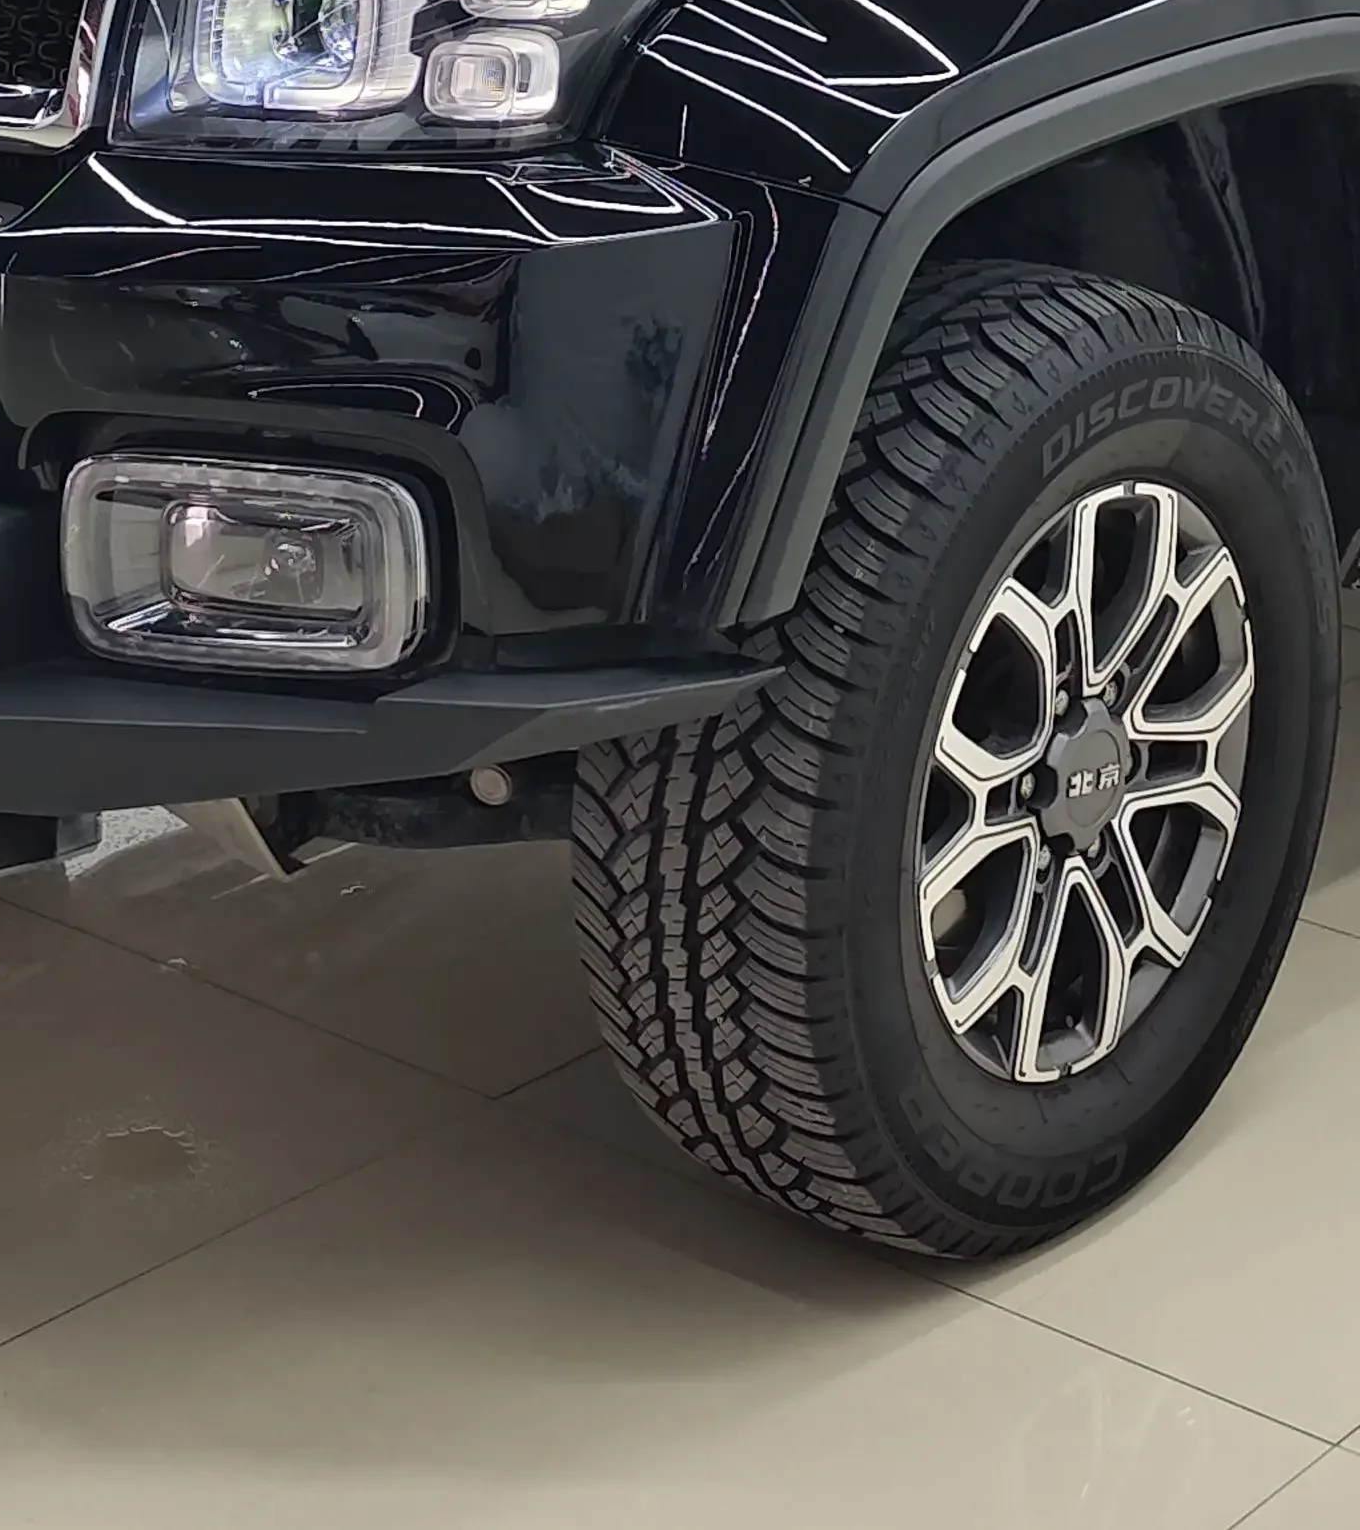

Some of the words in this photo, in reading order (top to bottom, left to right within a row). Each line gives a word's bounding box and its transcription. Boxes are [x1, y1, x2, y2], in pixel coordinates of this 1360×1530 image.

[1040, 375, 1301, 494] DISCOVERER
[1068, 763, 1121, 798] 北京
[897, 1074, 1129, 1209] COOPER
